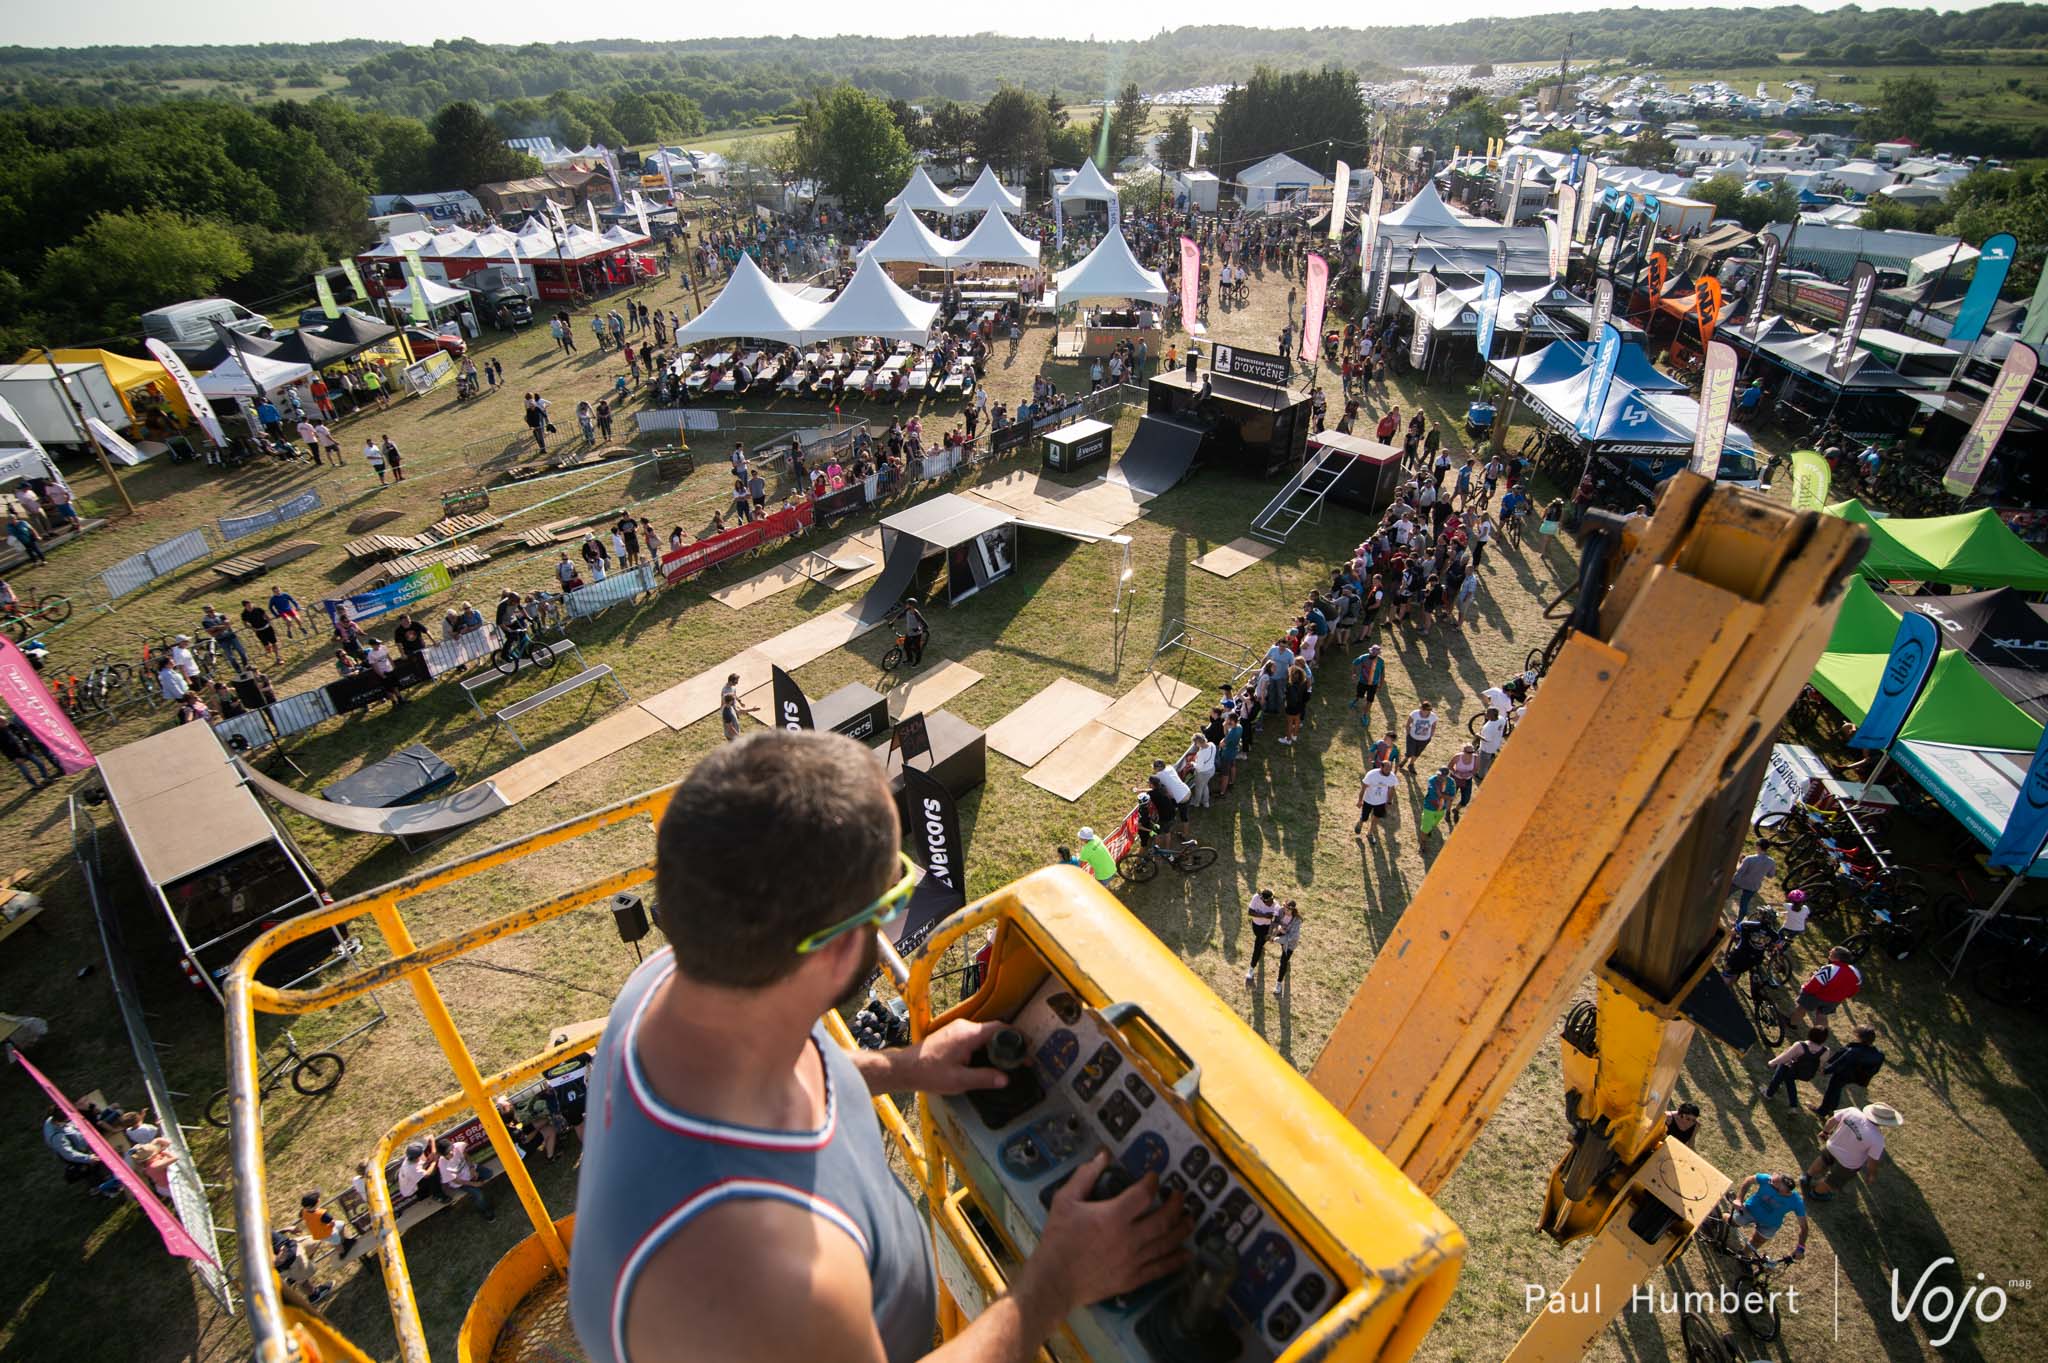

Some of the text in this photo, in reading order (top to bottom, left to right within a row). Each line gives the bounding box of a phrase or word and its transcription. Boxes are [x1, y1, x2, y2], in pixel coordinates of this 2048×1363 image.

[1234, 361, 1285, 380] D'OXYGÈNE
[1487, 365, 1517, 392] LAPIERE
[1522, 392, 1584, 446] LAPIERRE
[1596, 443, 1692, 456] LAPIERRE
[1889, 652, 1916, 685] ibis
[846, 720, 872, 738] cors
[1770, 751, 1801, 797] daBikes
[924, 798, 950, 882] Vercors
